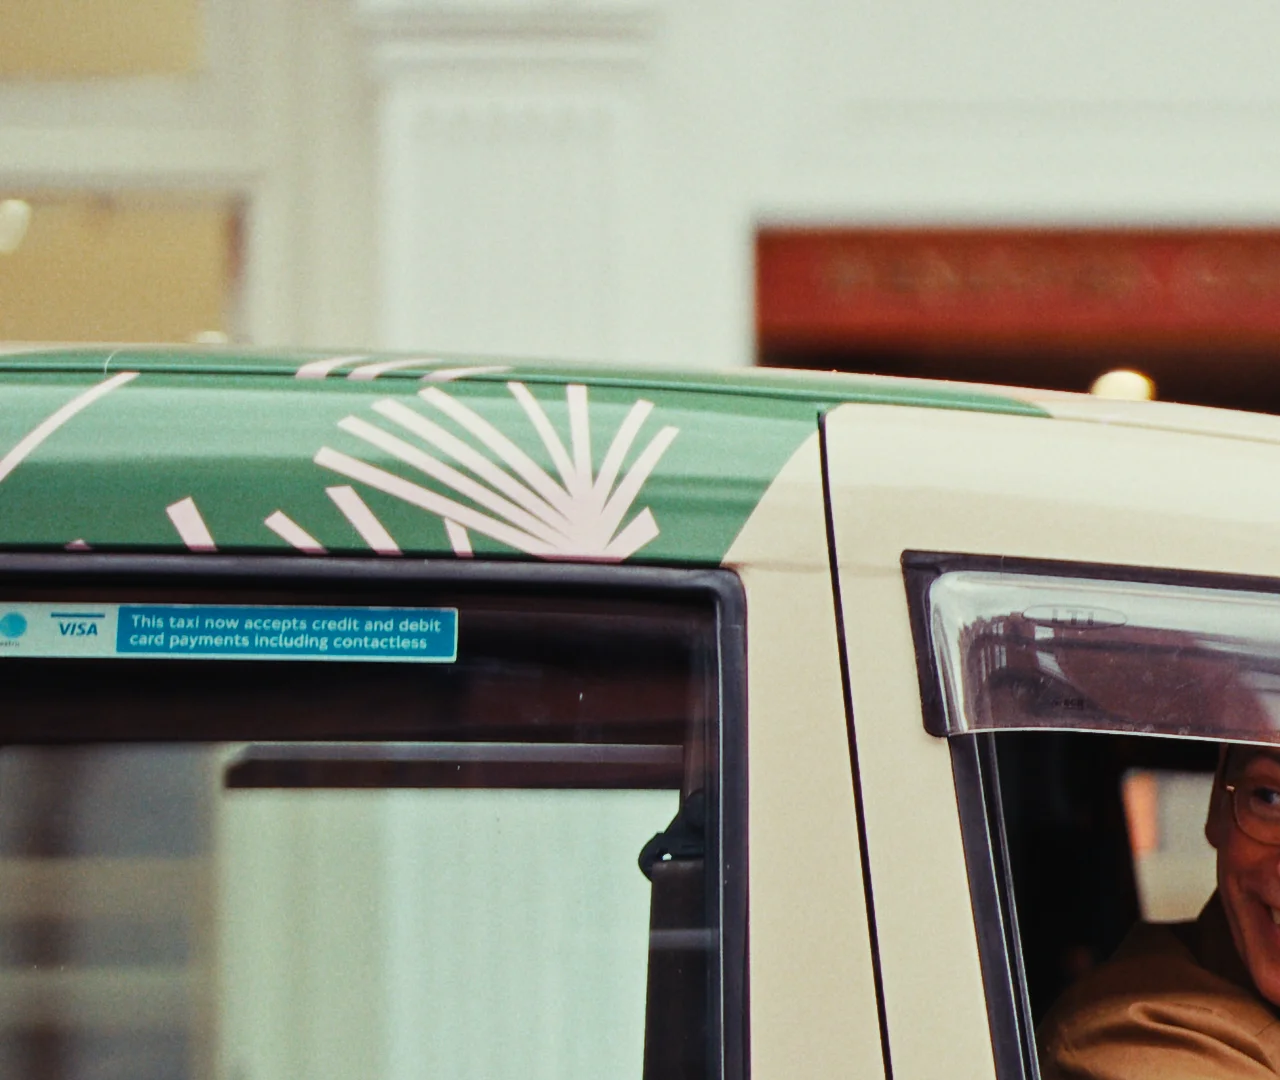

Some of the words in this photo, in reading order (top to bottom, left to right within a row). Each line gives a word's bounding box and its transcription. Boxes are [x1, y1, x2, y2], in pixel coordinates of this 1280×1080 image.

[59, 622, 98, 636] VISA
[131, 614, 164, 629] This
[169, 615, 200, 629] taxi
[205, 618, 239, 629] now
[244, 617, 307, 632] accepts
[312, 617, 359, 631] credit
[364, 618, 394, 631] and
[399, 618, 441, 633] debit
[129, 632, 164, 646] card
[169, 633, 249, 649] payments
[254, 633, 328, 651] including
[333, 635, 427, 650] contactless
